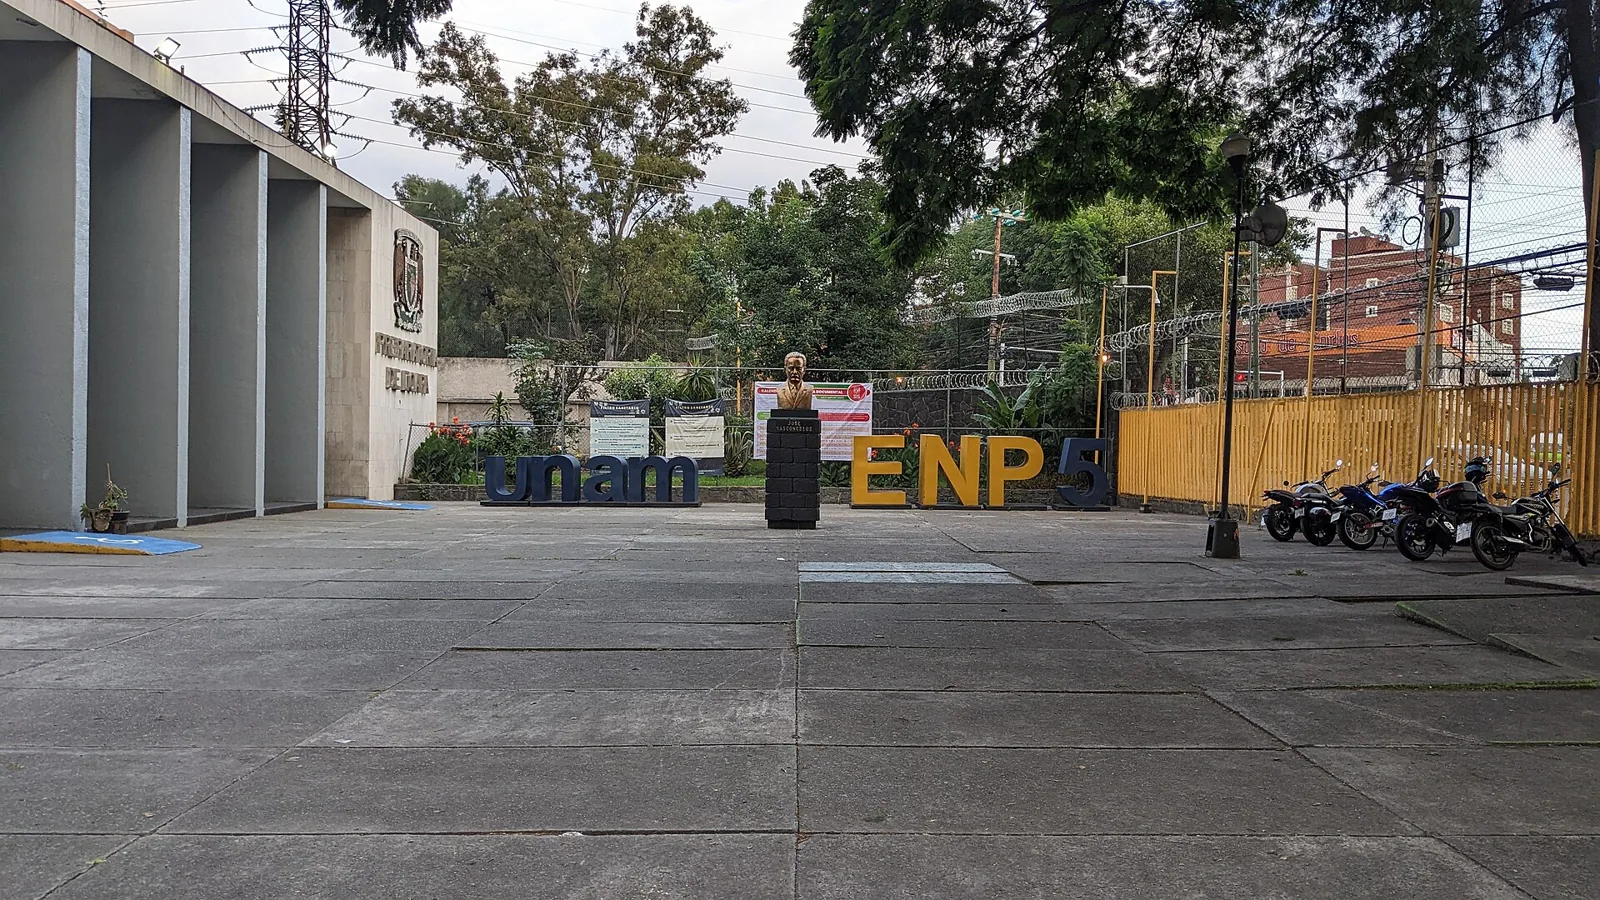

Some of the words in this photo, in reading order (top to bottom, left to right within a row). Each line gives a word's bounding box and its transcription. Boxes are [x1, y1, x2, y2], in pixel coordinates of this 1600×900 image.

[485, 454, 699, 503] unam
[852, 434, 1044, 506] ENP
[1057, 437, 1111, 507] 5
